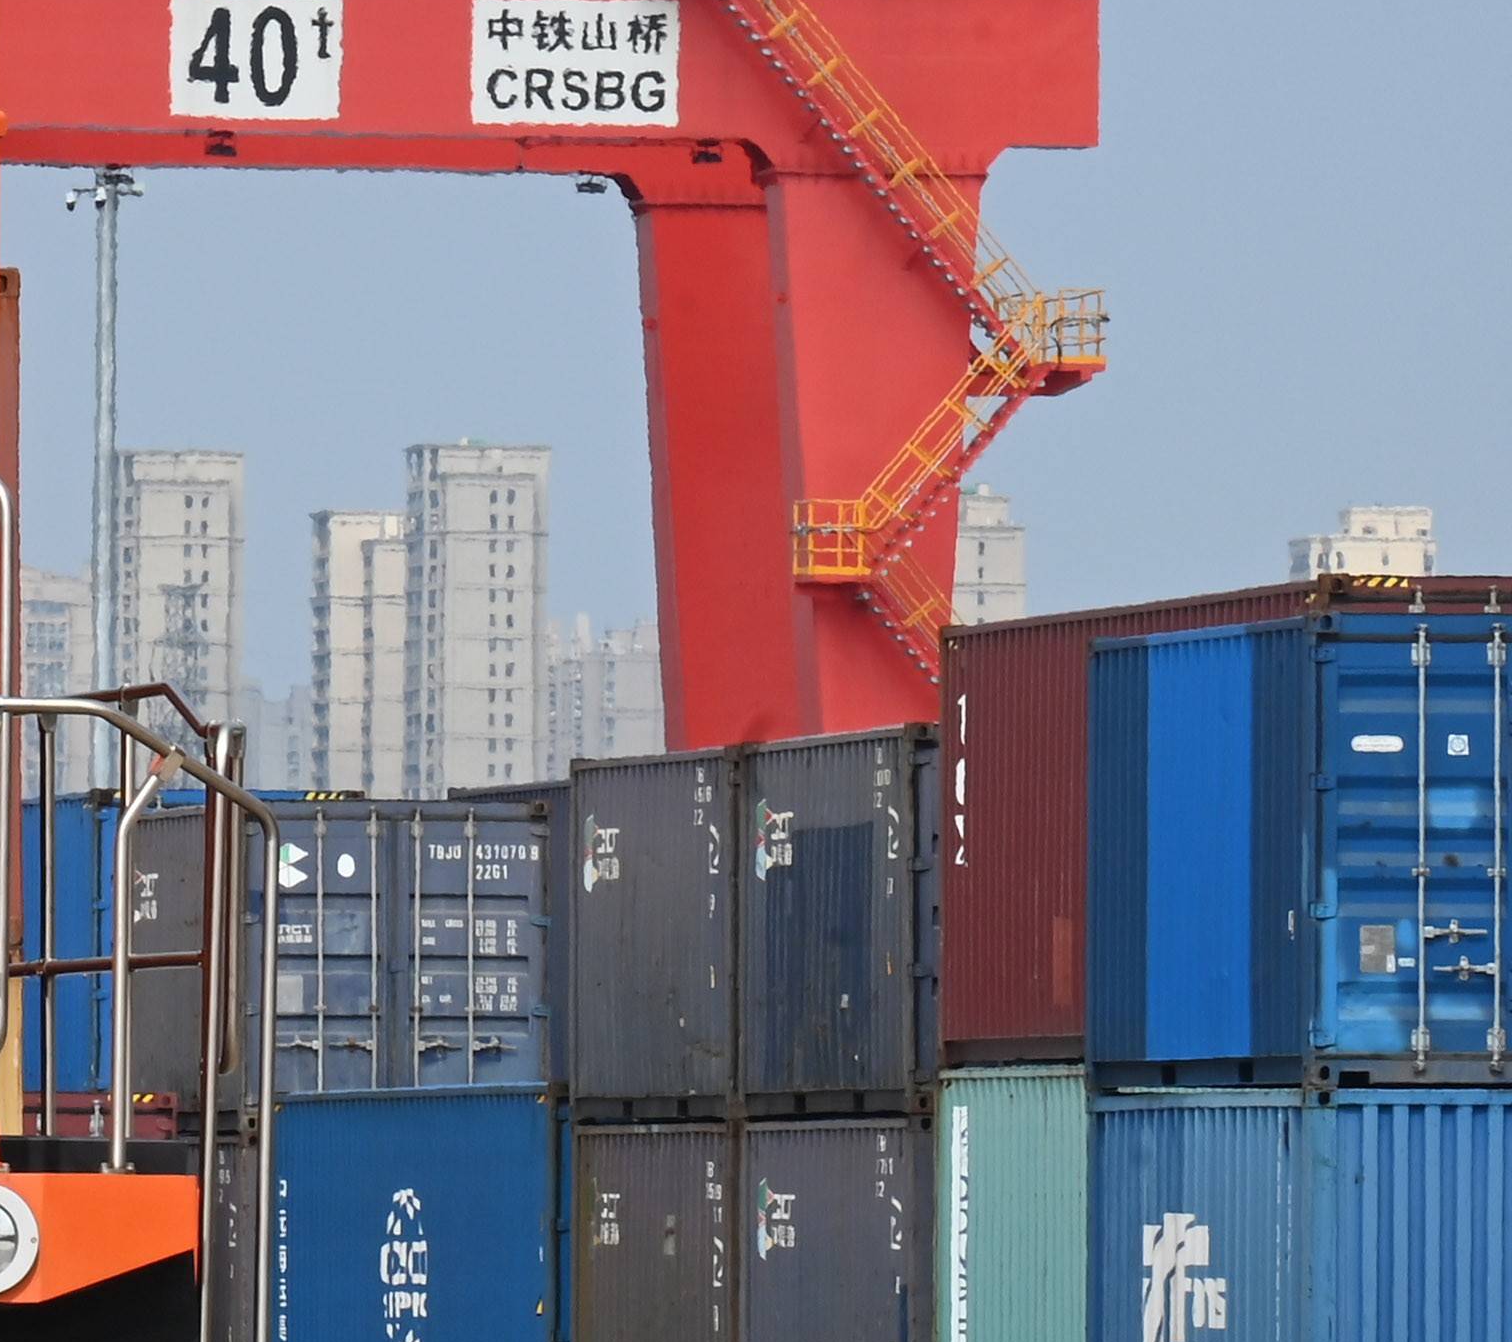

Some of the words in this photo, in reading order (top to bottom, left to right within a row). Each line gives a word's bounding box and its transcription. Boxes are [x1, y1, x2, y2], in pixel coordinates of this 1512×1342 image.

[485, 8, 668, 55] 中铁山桥
[485, 68, 666, 112] CRSBG
[475, 864, 508, 880] 22G1
